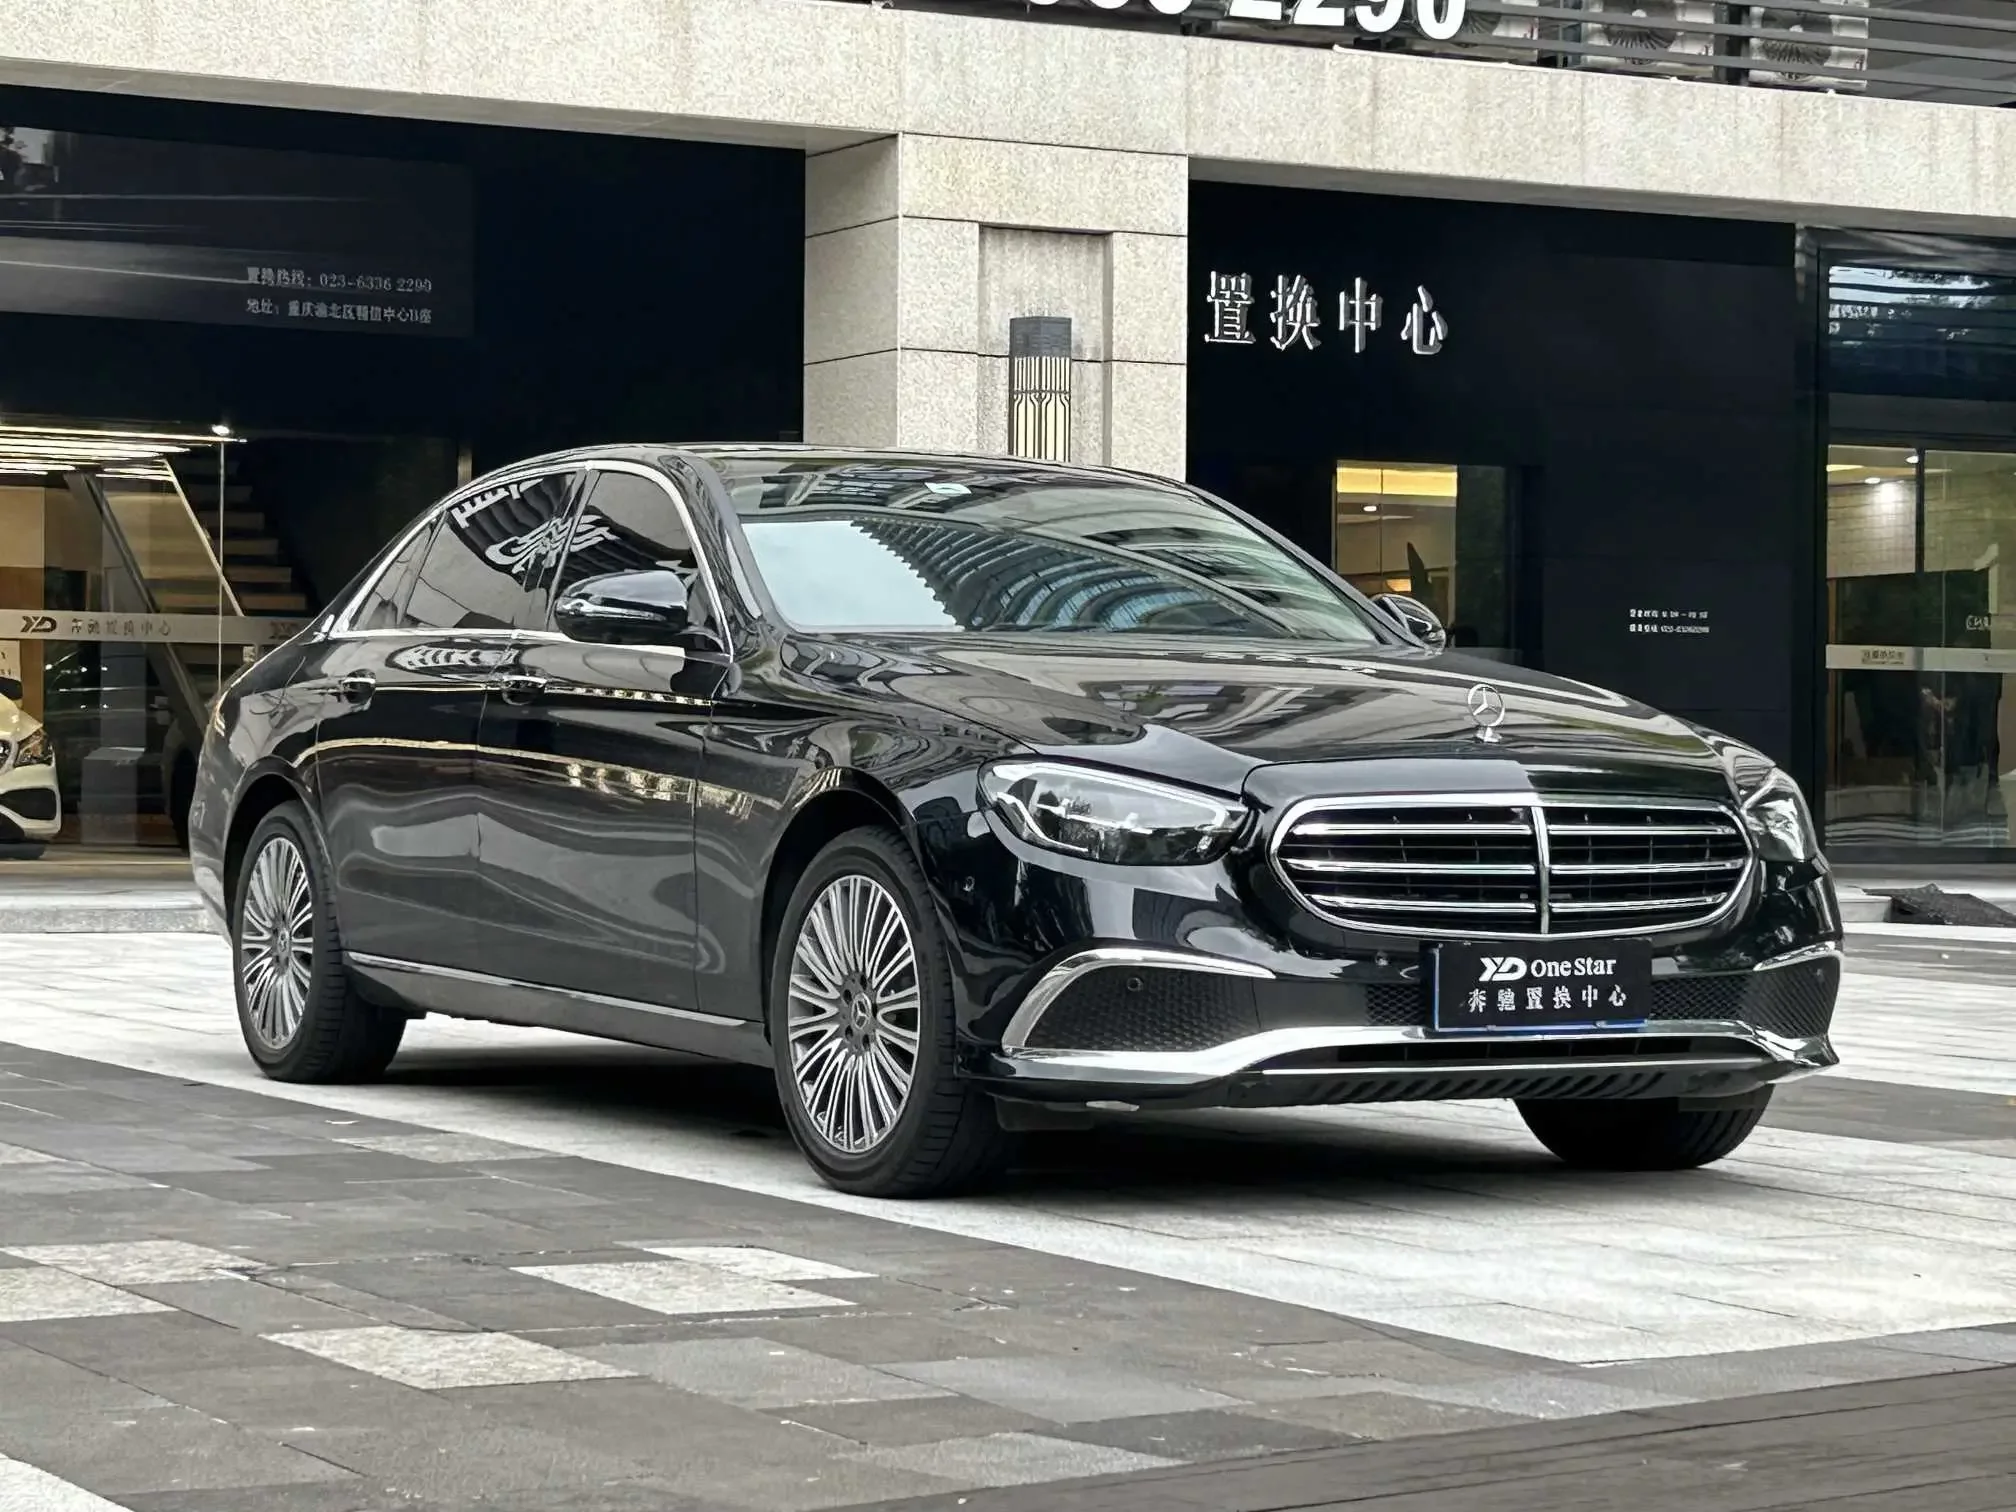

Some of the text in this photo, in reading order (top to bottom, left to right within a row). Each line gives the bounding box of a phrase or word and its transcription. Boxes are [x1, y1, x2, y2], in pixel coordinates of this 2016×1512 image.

[1204, 270, 1448, 354] 置换中心
[1530, 960, 1571, 978] One
[1574, 957, 1617, 976] Star
